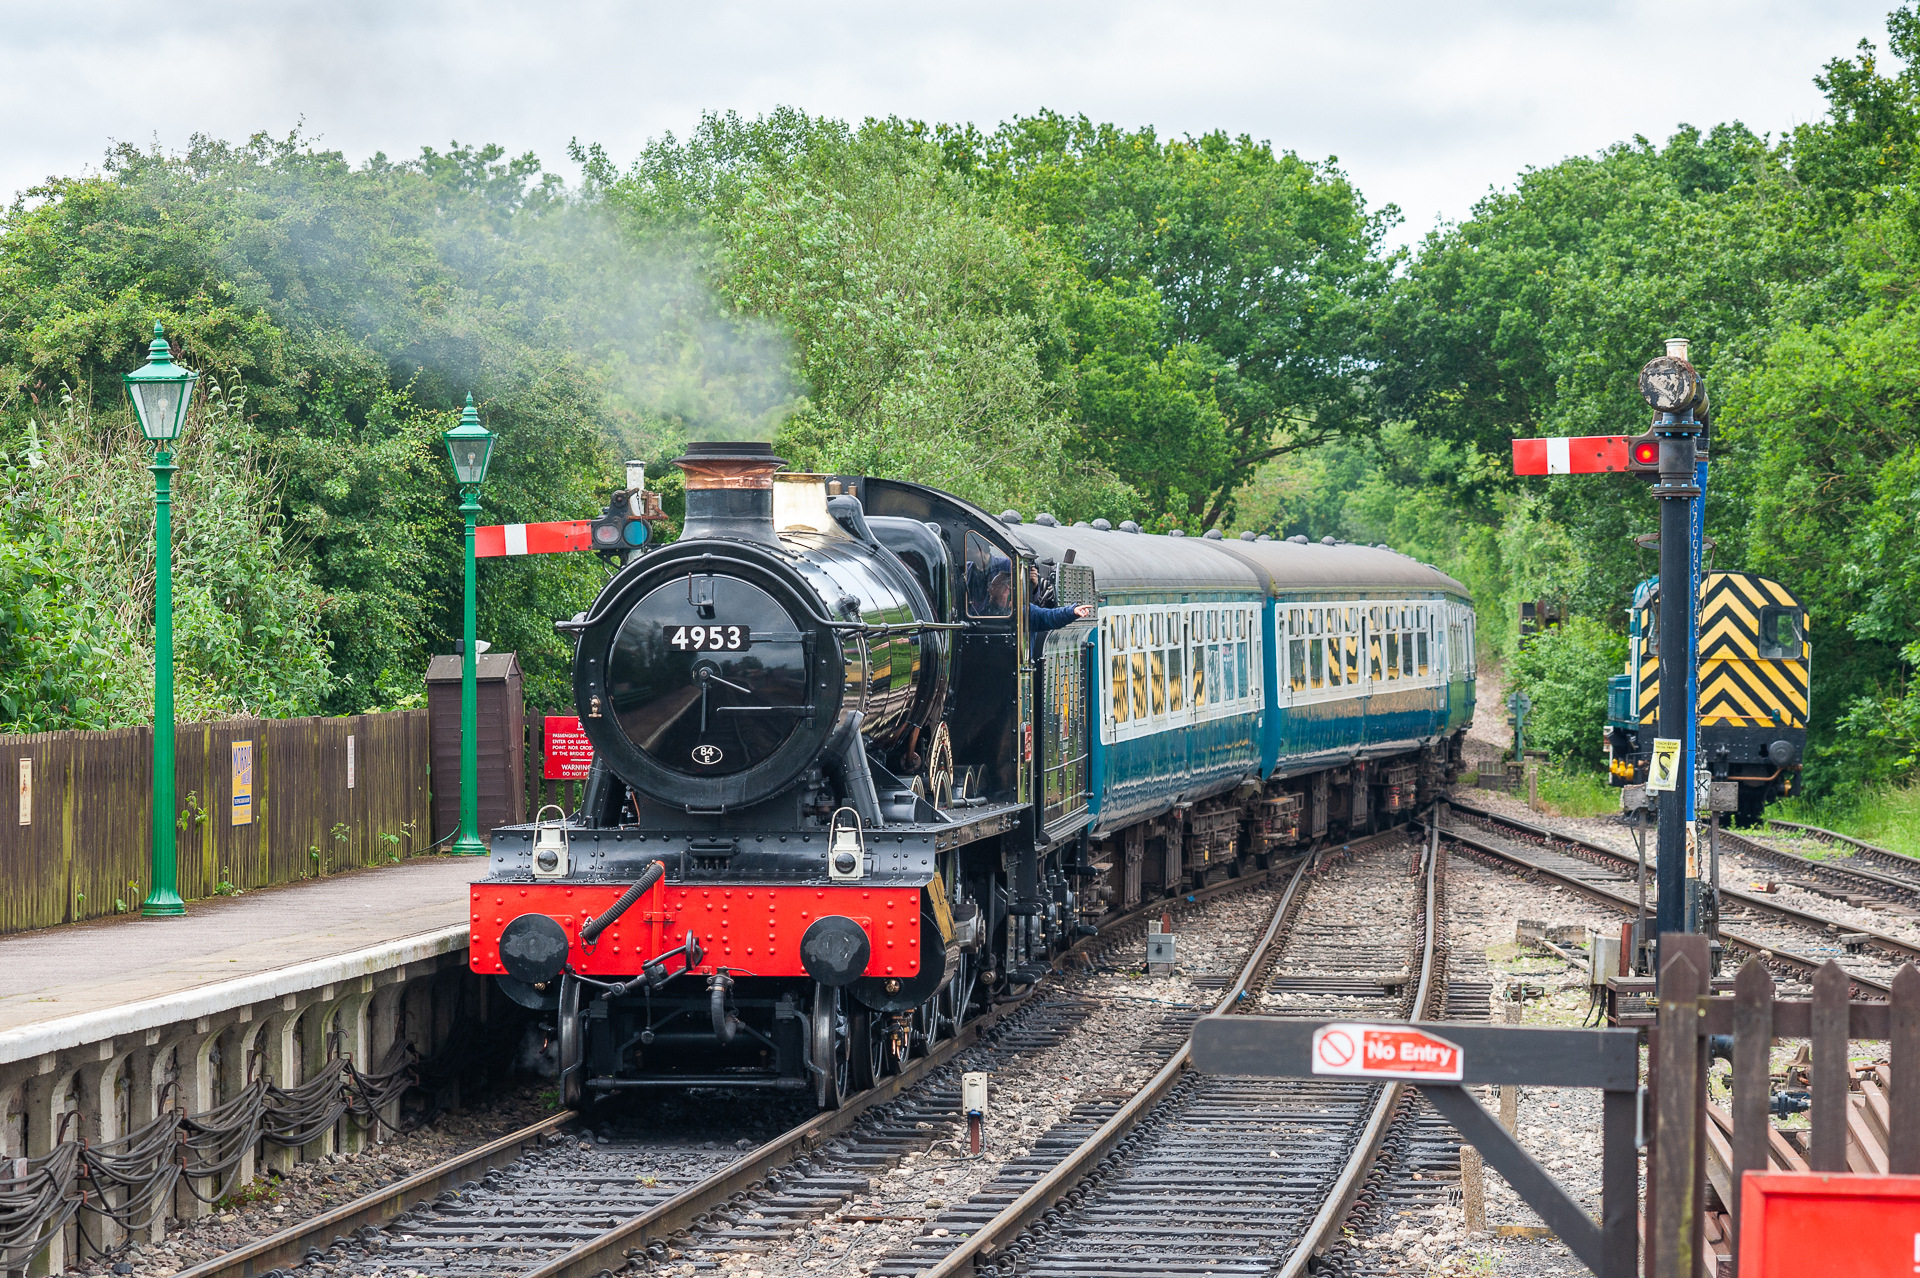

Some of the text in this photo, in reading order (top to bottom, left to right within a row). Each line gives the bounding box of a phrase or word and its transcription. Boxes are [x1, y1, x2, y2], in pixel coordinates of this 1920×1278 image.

[671, 626, 741, 650] 4953
[700, 747, 714, 756] 84
[1367, 1040, 1452, 1067] No Entry
